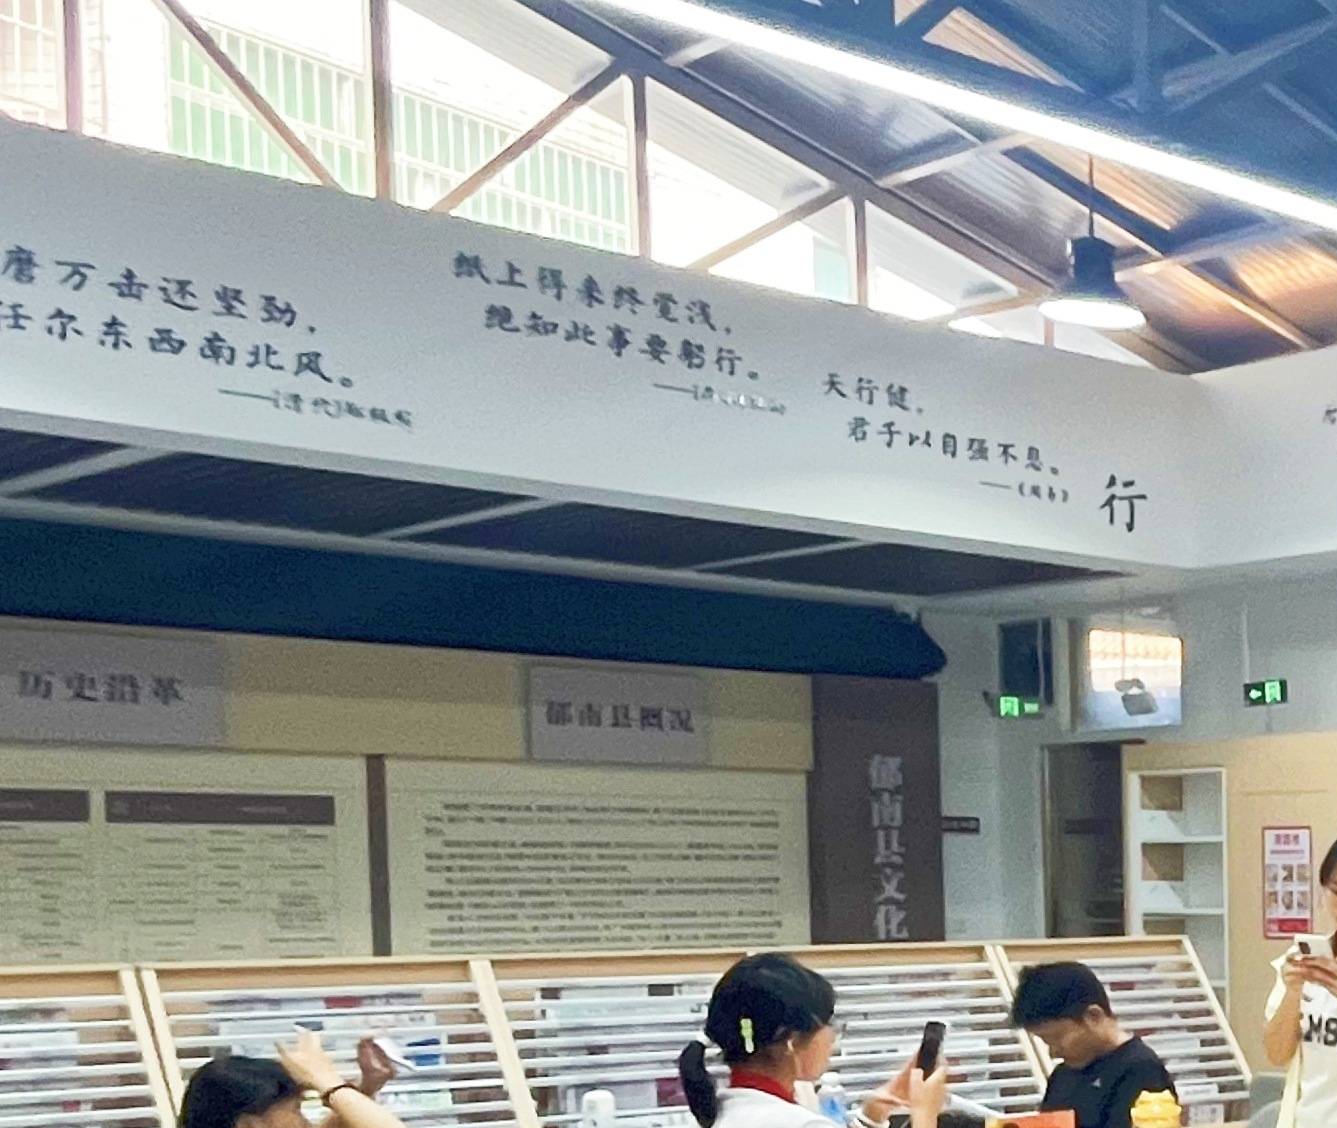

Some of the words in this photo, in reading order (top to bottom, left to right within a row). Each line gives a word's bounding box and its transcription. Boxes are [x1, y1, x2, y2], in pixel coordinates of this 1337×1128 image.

[823, 373, 924, 414] 天行健，
[848, 416, 1059, 475] 君子以自强不息。
[1099, 474, 1147, 532] 行
[18, 669, 185, 705] 历史沿革
